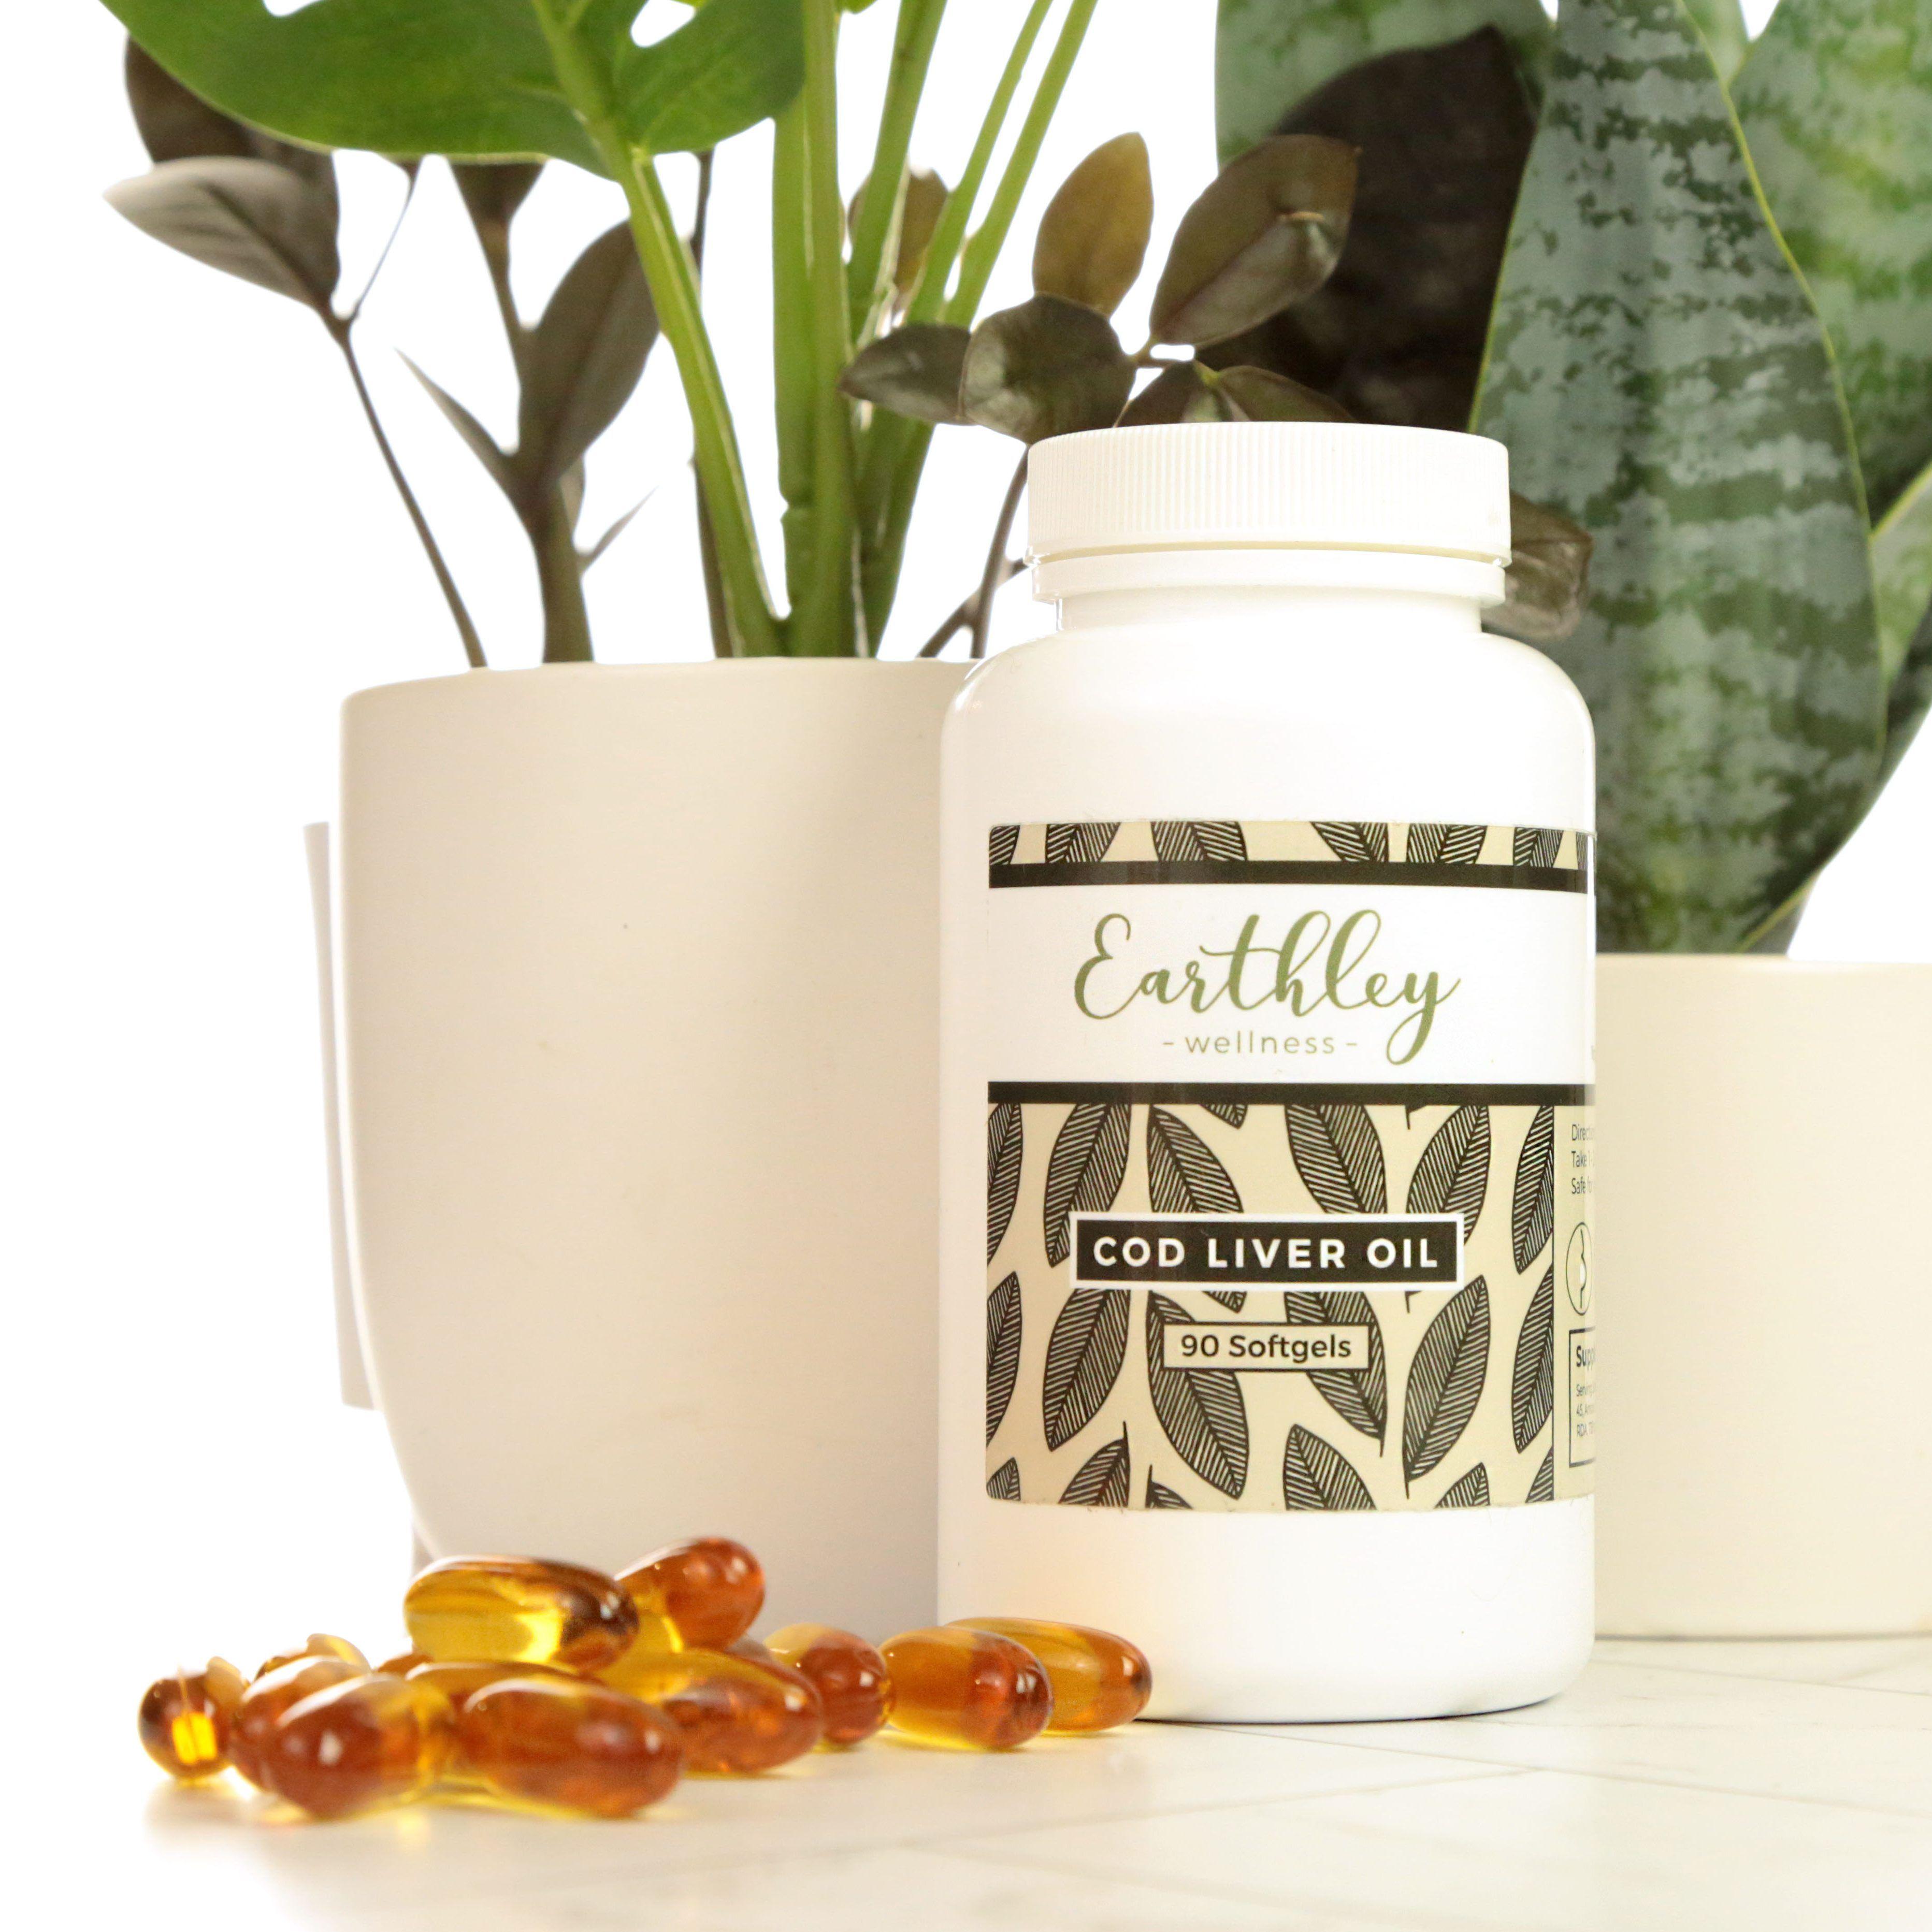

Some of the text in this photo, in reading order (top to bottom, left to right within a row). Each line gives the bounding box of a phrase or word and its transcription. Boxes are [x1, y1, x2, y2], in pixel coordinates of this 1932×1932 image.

[1074, 910, 1461, 1065] Earthley
[1185, 1031, 1335, 1054] wellness
[1093, 1236, 1438, 1268] COD LIVER OIL
[1181, 1334, 1351, 1364] 90 Softgels
